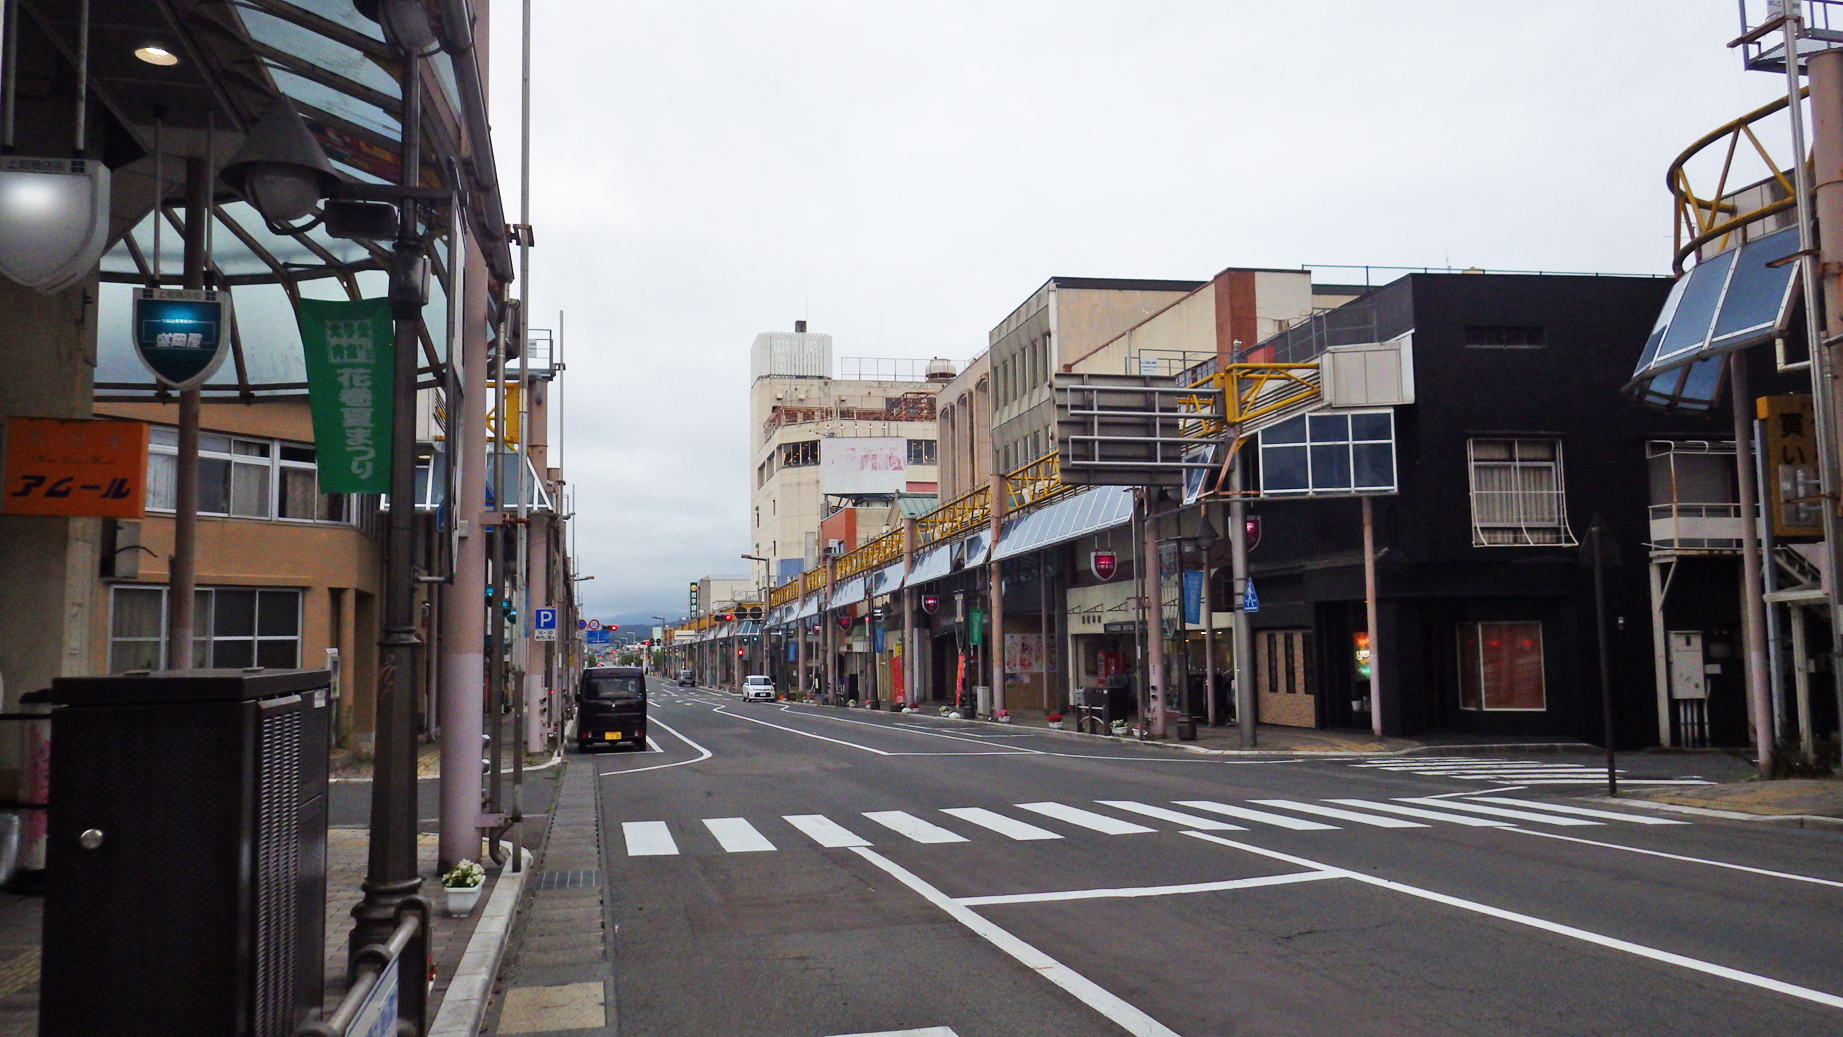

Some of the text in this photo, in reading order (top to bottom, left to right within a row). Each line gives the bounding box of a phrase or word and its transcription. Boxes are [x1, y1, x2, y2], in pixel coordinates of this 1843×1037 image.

[336, 367, 376, 480] 花巻夏まつり
[10, 474, 131, 500] アムール
[540, 611, 553, 627] P
